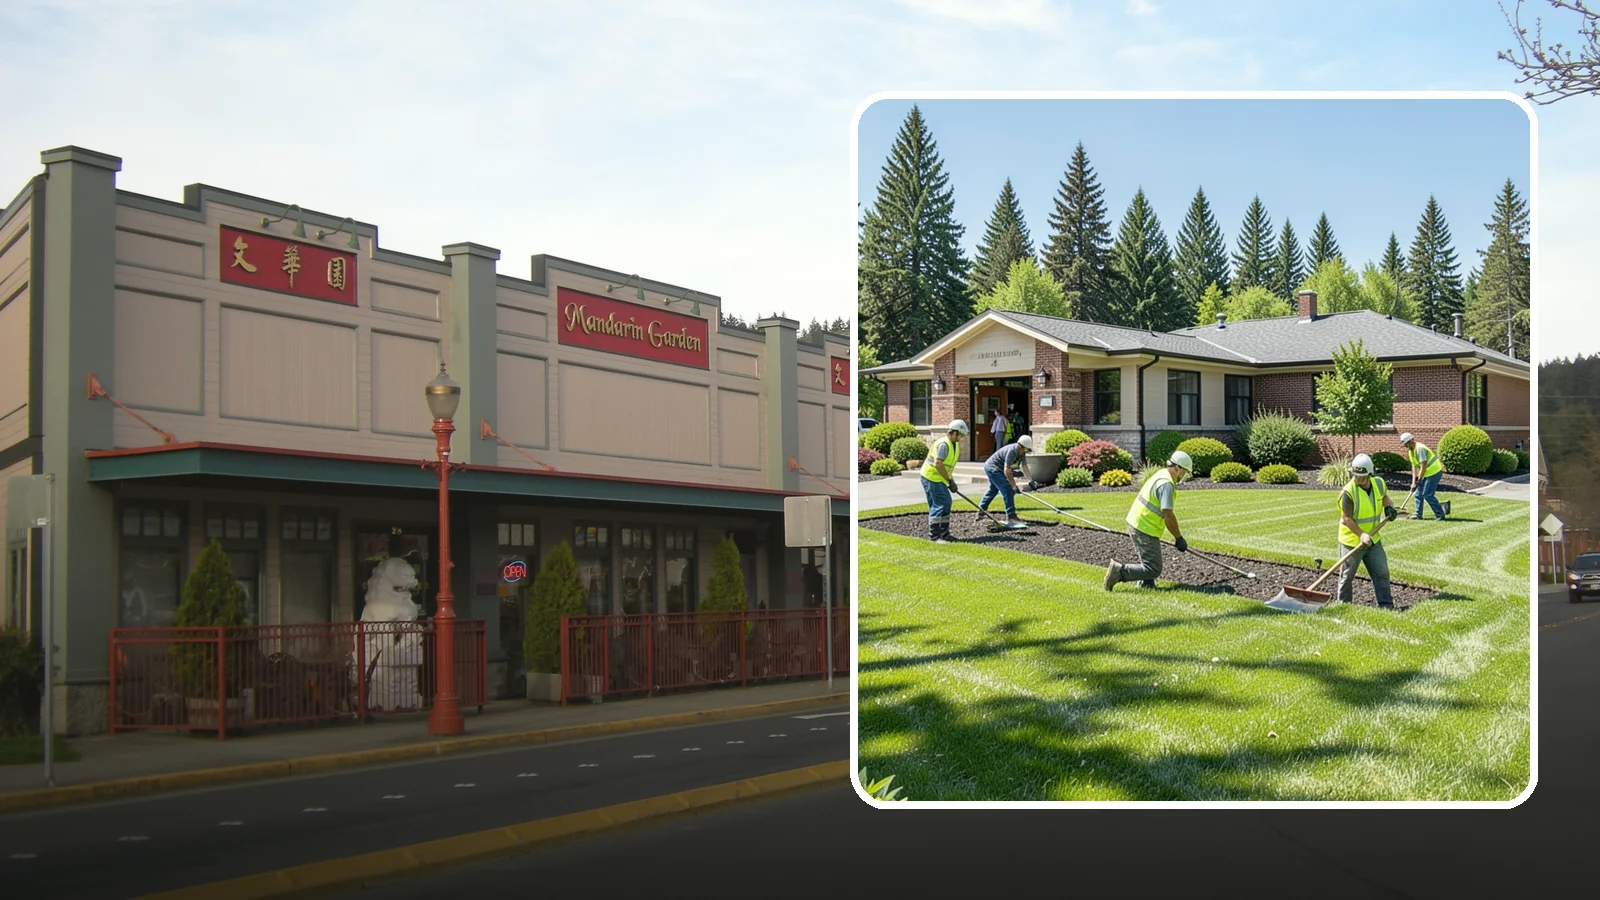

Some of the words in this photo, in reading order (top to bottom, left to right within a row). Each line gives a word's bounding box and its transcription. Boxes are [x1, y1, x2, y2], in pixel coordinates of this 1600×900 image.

[231, 235, 346, 291] 文華園
[564, 302, 644, 341] Mandarin
[648, 320, 702, 352] Garden
[503, 565, 527, 578] OPEN
